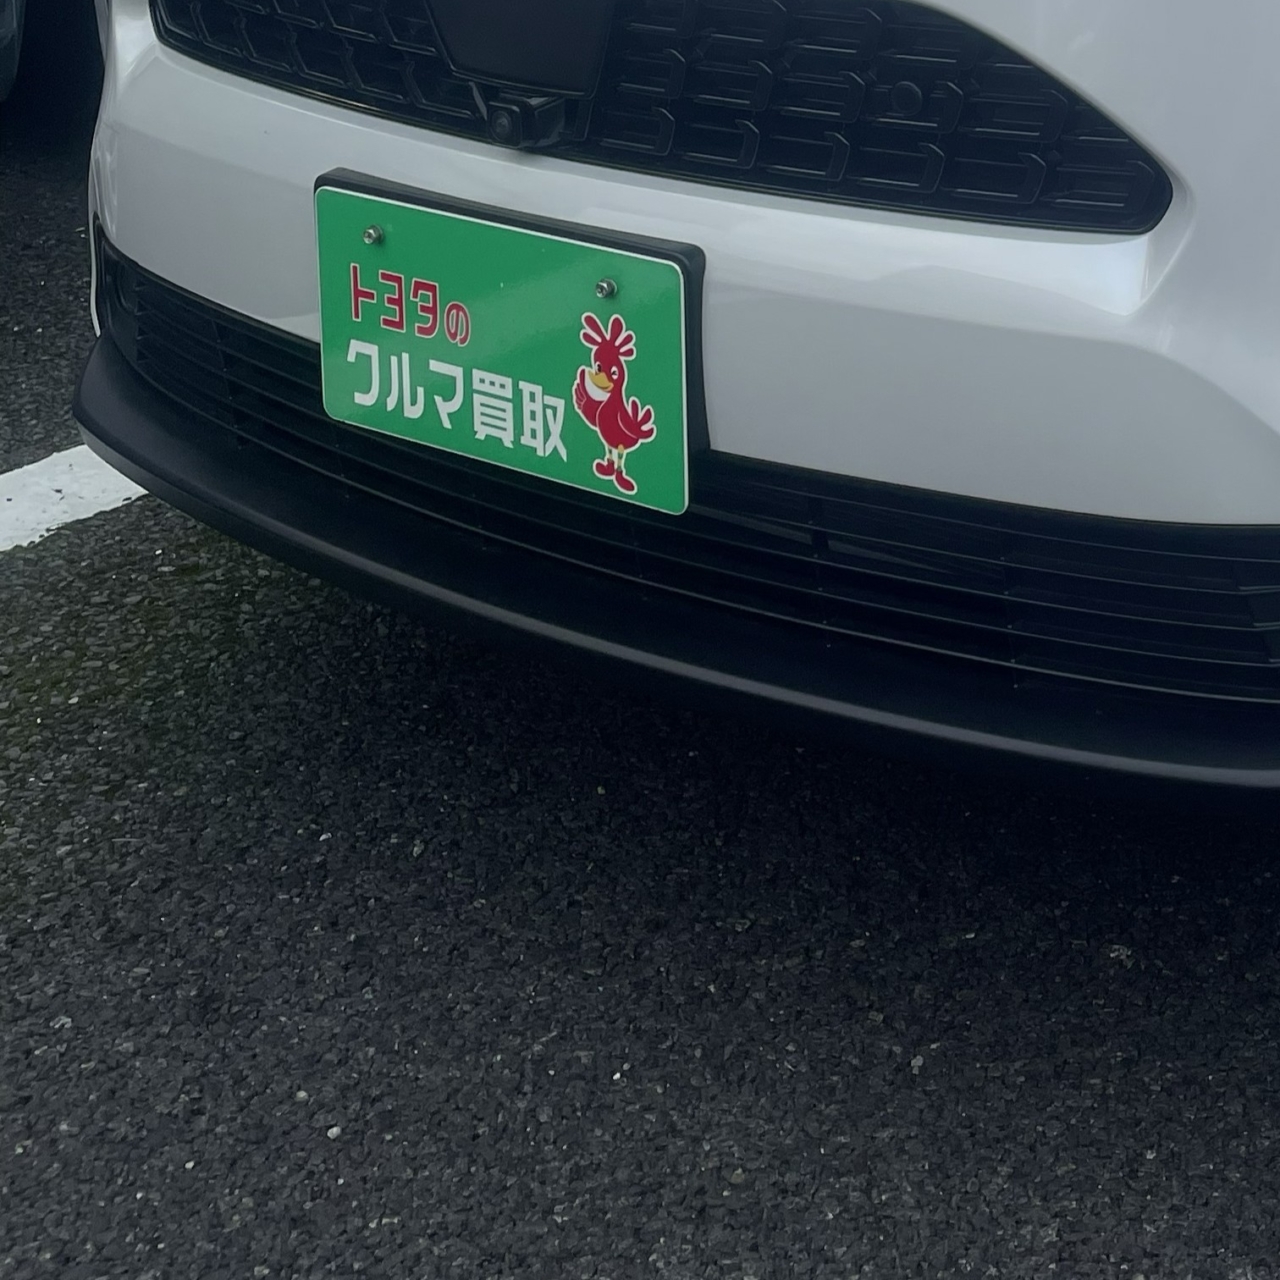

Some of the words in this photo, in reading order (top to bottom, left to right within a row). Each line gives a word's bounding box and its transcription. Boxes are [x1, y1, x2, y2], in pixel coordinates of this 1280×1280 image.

[349, 263, 471, 347] トヨタの
[346, 339, 568, 463] クルマ買取
